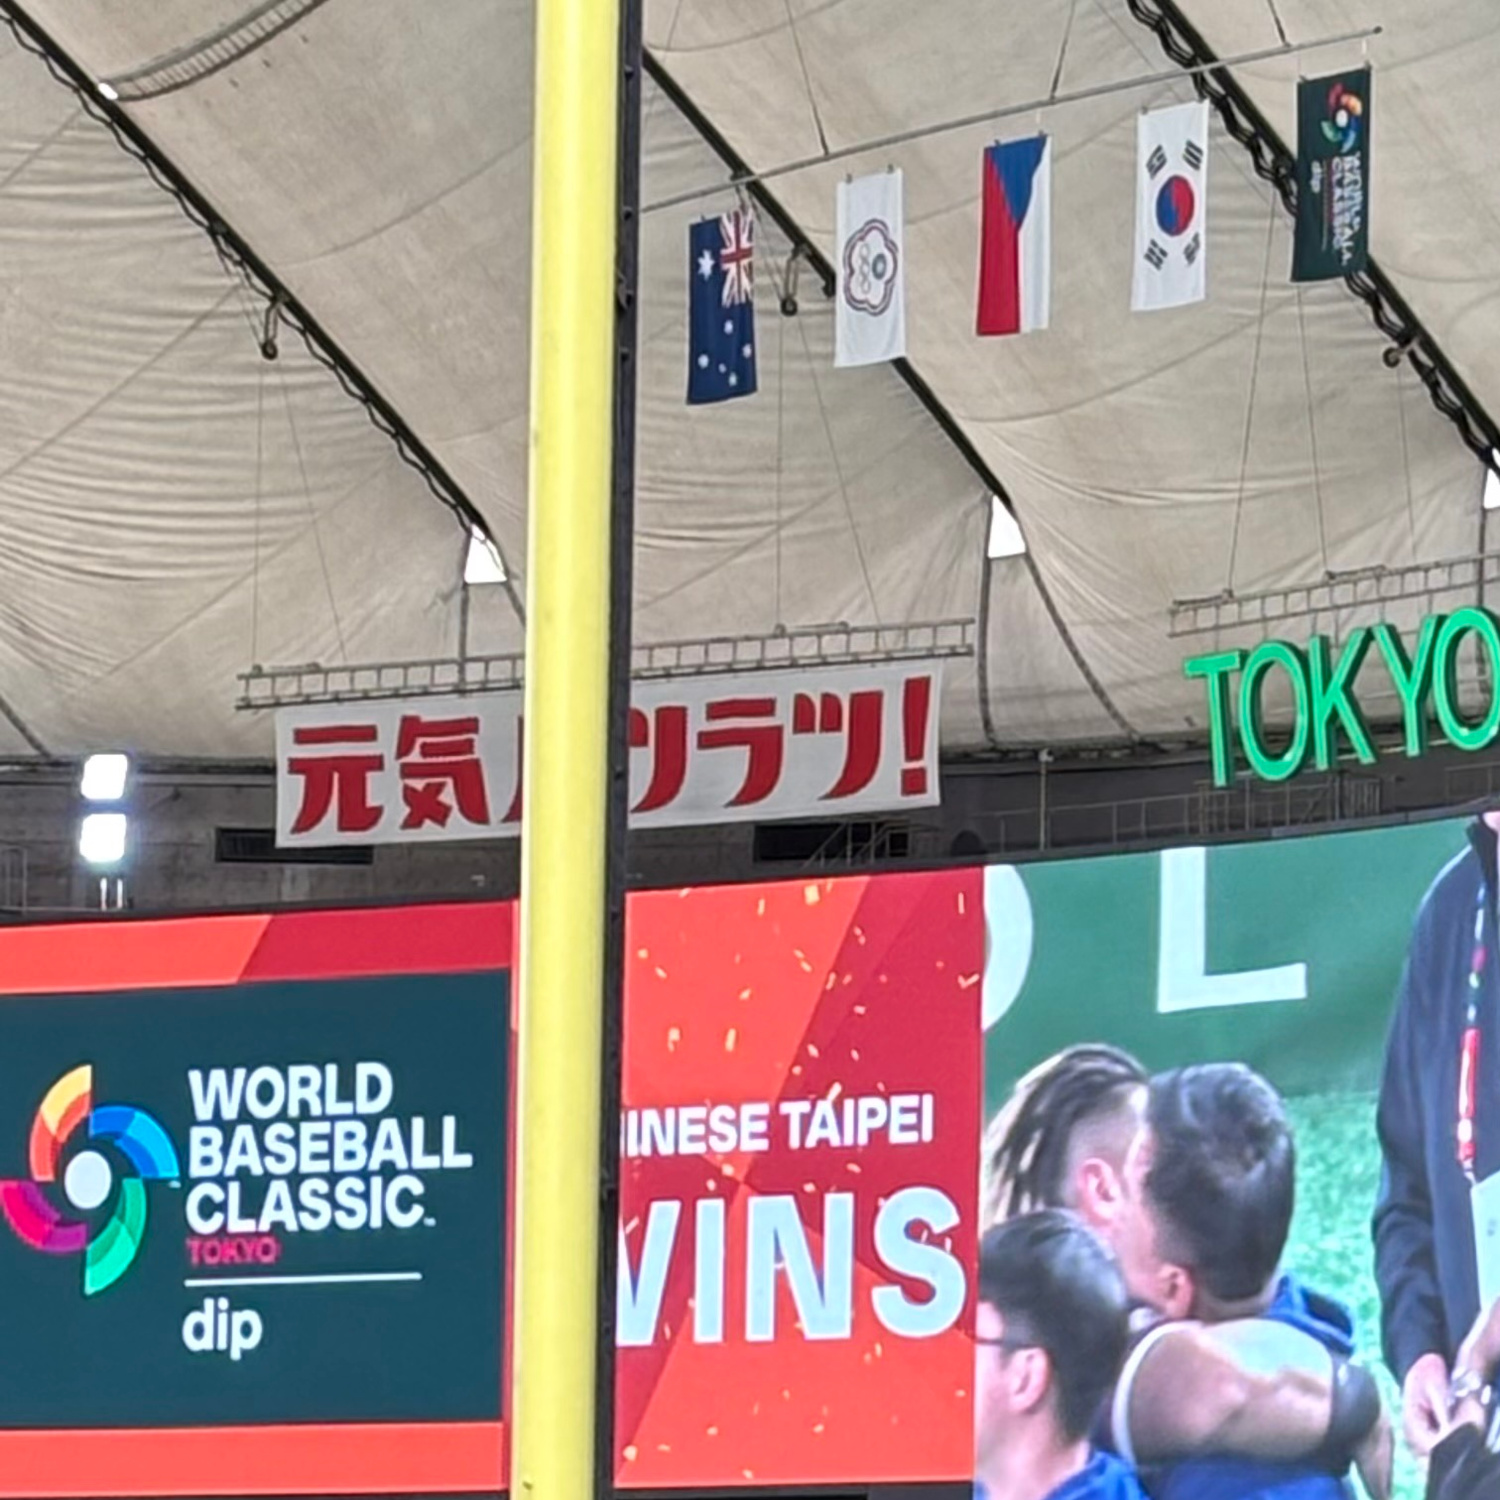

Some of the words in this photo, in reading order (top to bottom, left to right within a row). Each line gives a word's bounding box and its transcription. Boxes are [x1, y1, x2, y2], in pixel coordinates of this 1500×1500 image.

[288, 676, 930, 835] 元気ツラツ!
[188, 1061, 394, 1121] WORLD
[188, 1115, 473, 1179] BASEBALL
[621, 1102, 771, 1158] INESE
[779, 1093, 934, 1150] TAIPEI
[186, 1236, 281, 1267] TOKYO
[182, 1297, 263, 1361] dip
